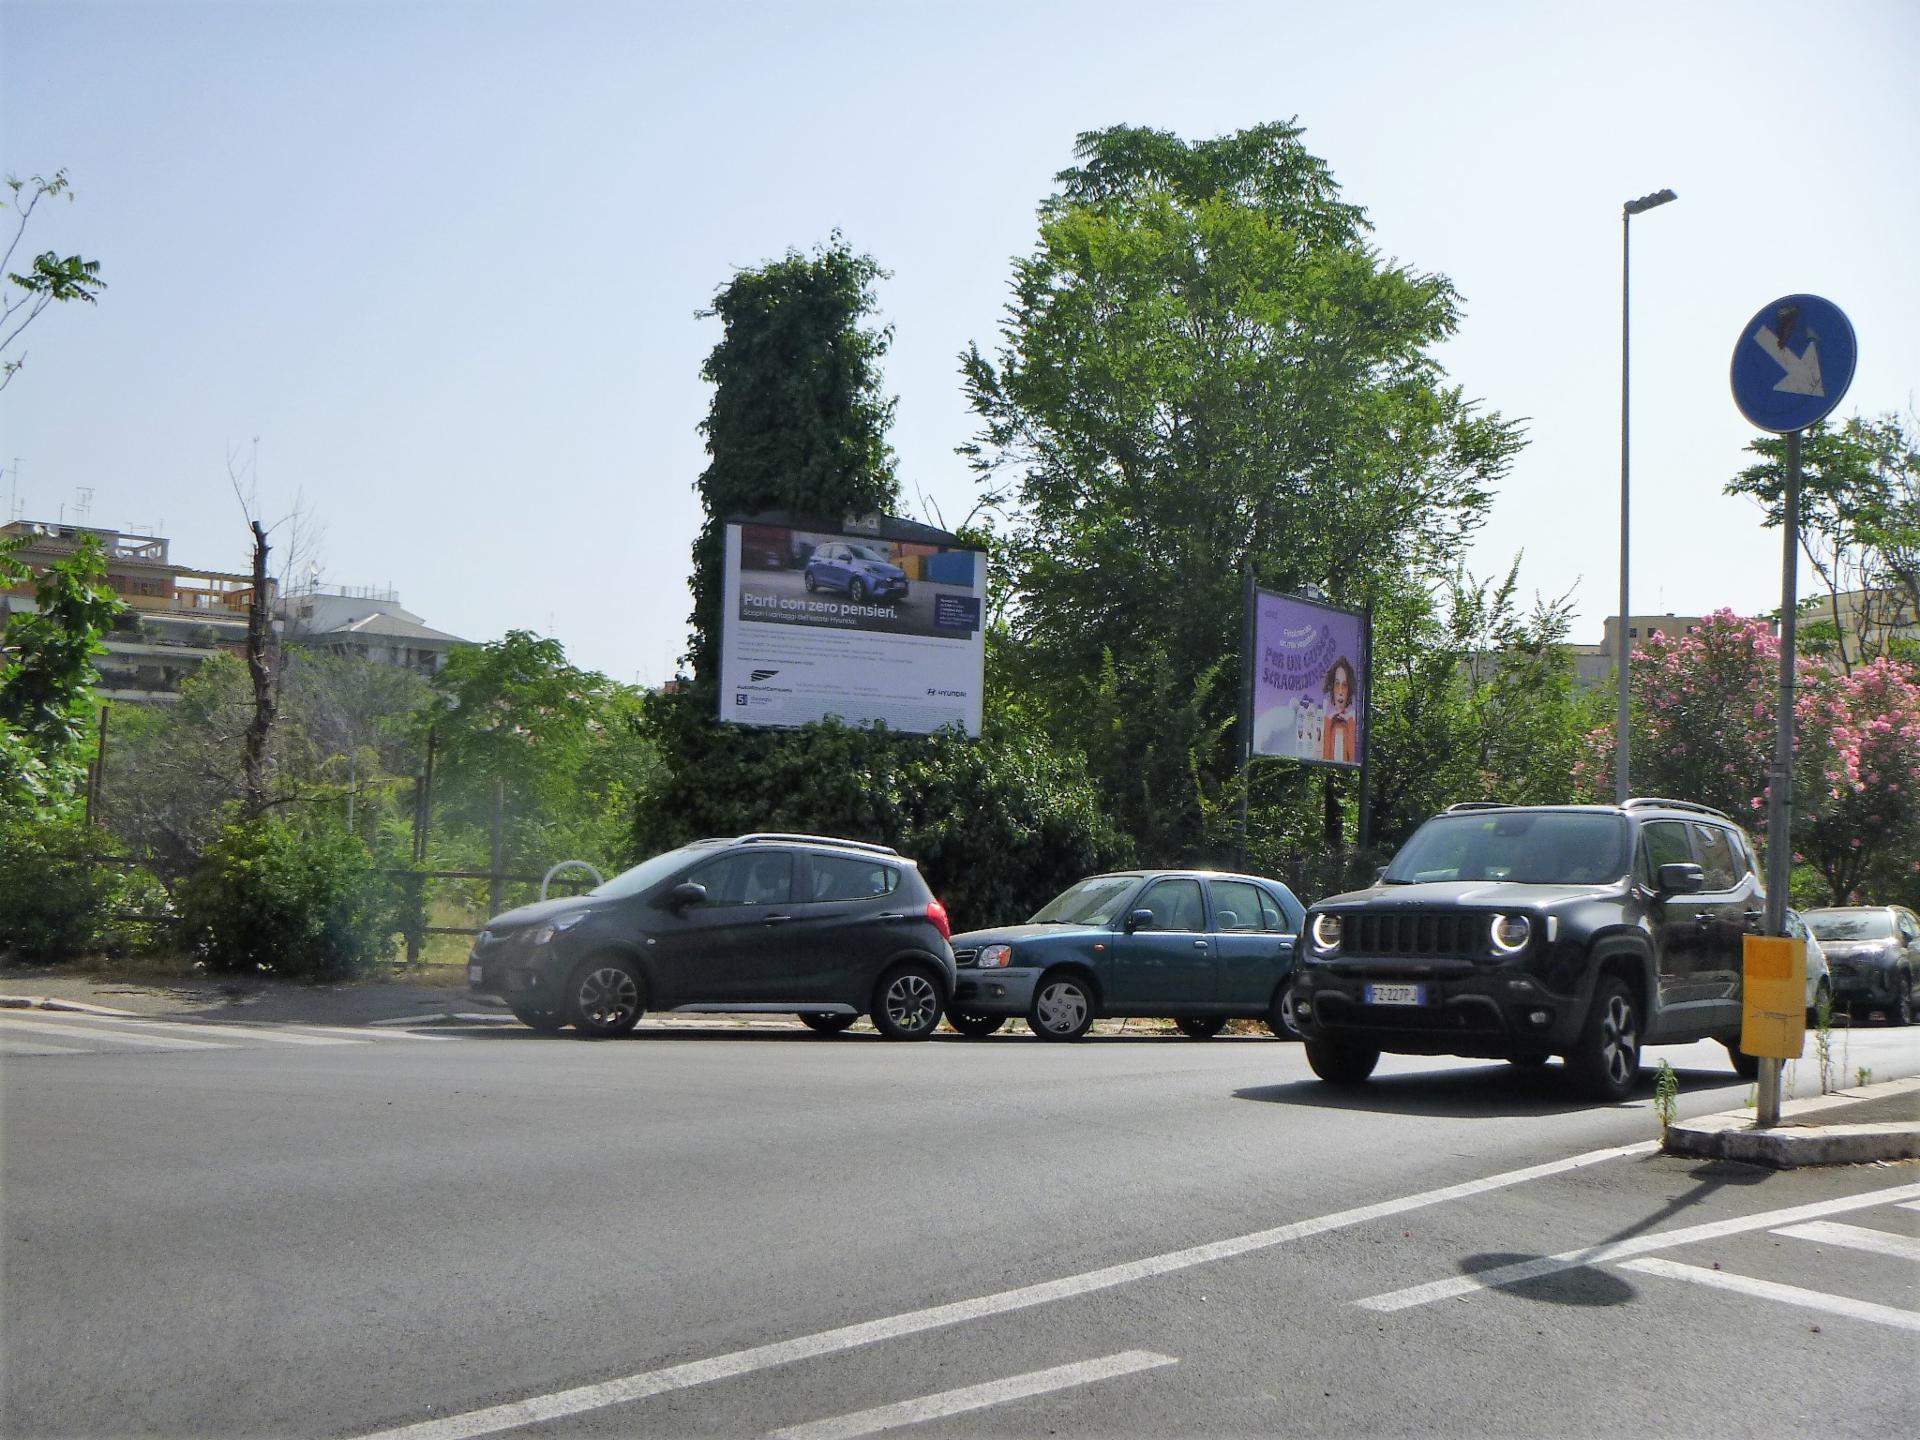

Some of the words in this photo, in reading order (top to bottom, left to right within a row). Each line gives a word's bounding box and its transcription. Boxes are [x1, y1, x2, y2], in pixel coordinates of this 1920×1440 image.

[744, 593, 777, 608] Parti
[780, 599, 806, 611] con
[808, 601, 838, 613] zero
[841, 604, 898, 619] pensieri.
